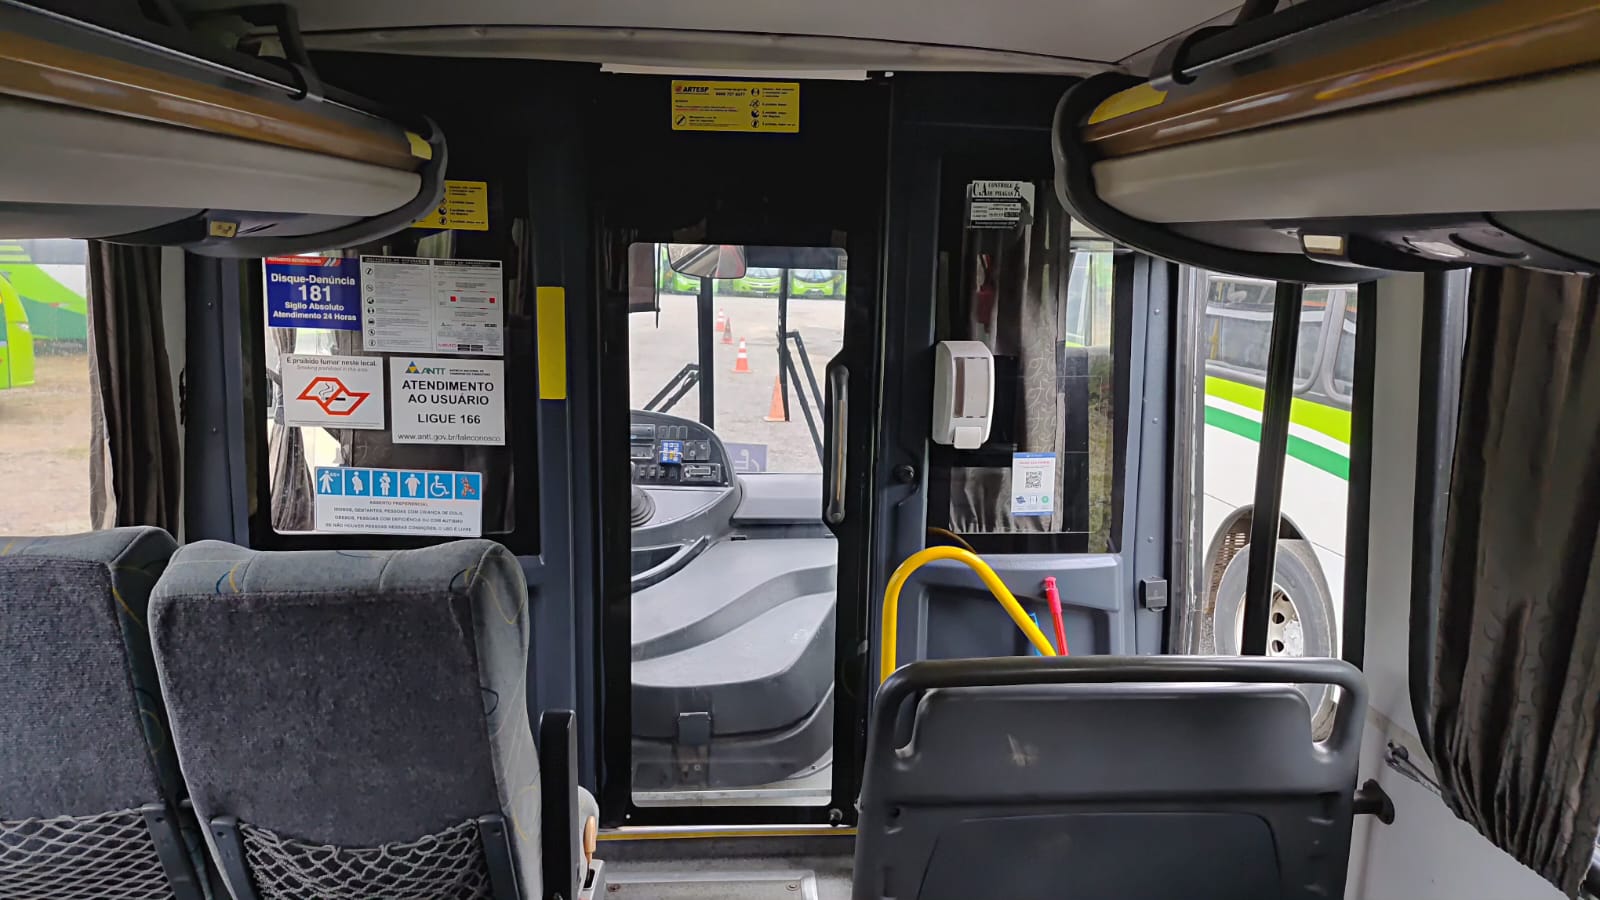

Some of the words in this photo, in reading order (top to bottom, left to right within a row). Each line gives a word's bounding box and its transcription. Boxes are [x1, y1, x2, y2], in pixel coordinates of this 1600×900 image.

[270, 273, 356, 285] Disque-Denúncia
[298, 284, 331, 302] 181
[284, 301, 308, 311] Sigilo
[309, 302, 345, 311] Absoluto
[273, 310, 322, 319] Atendimento
[323, 312, 333, 320] 24
[334, 313, 357, 321] Horas
[421, 367, 446, 375] ANTT
[402, 380, 494, 391] ATENDIMENTO
[408, 394, 427, 403] AO
[431, 392, 489, 405] USUÁRIO
[417, 413, 456, 423] LIGUE
[460, 414, 481, 424] 166
